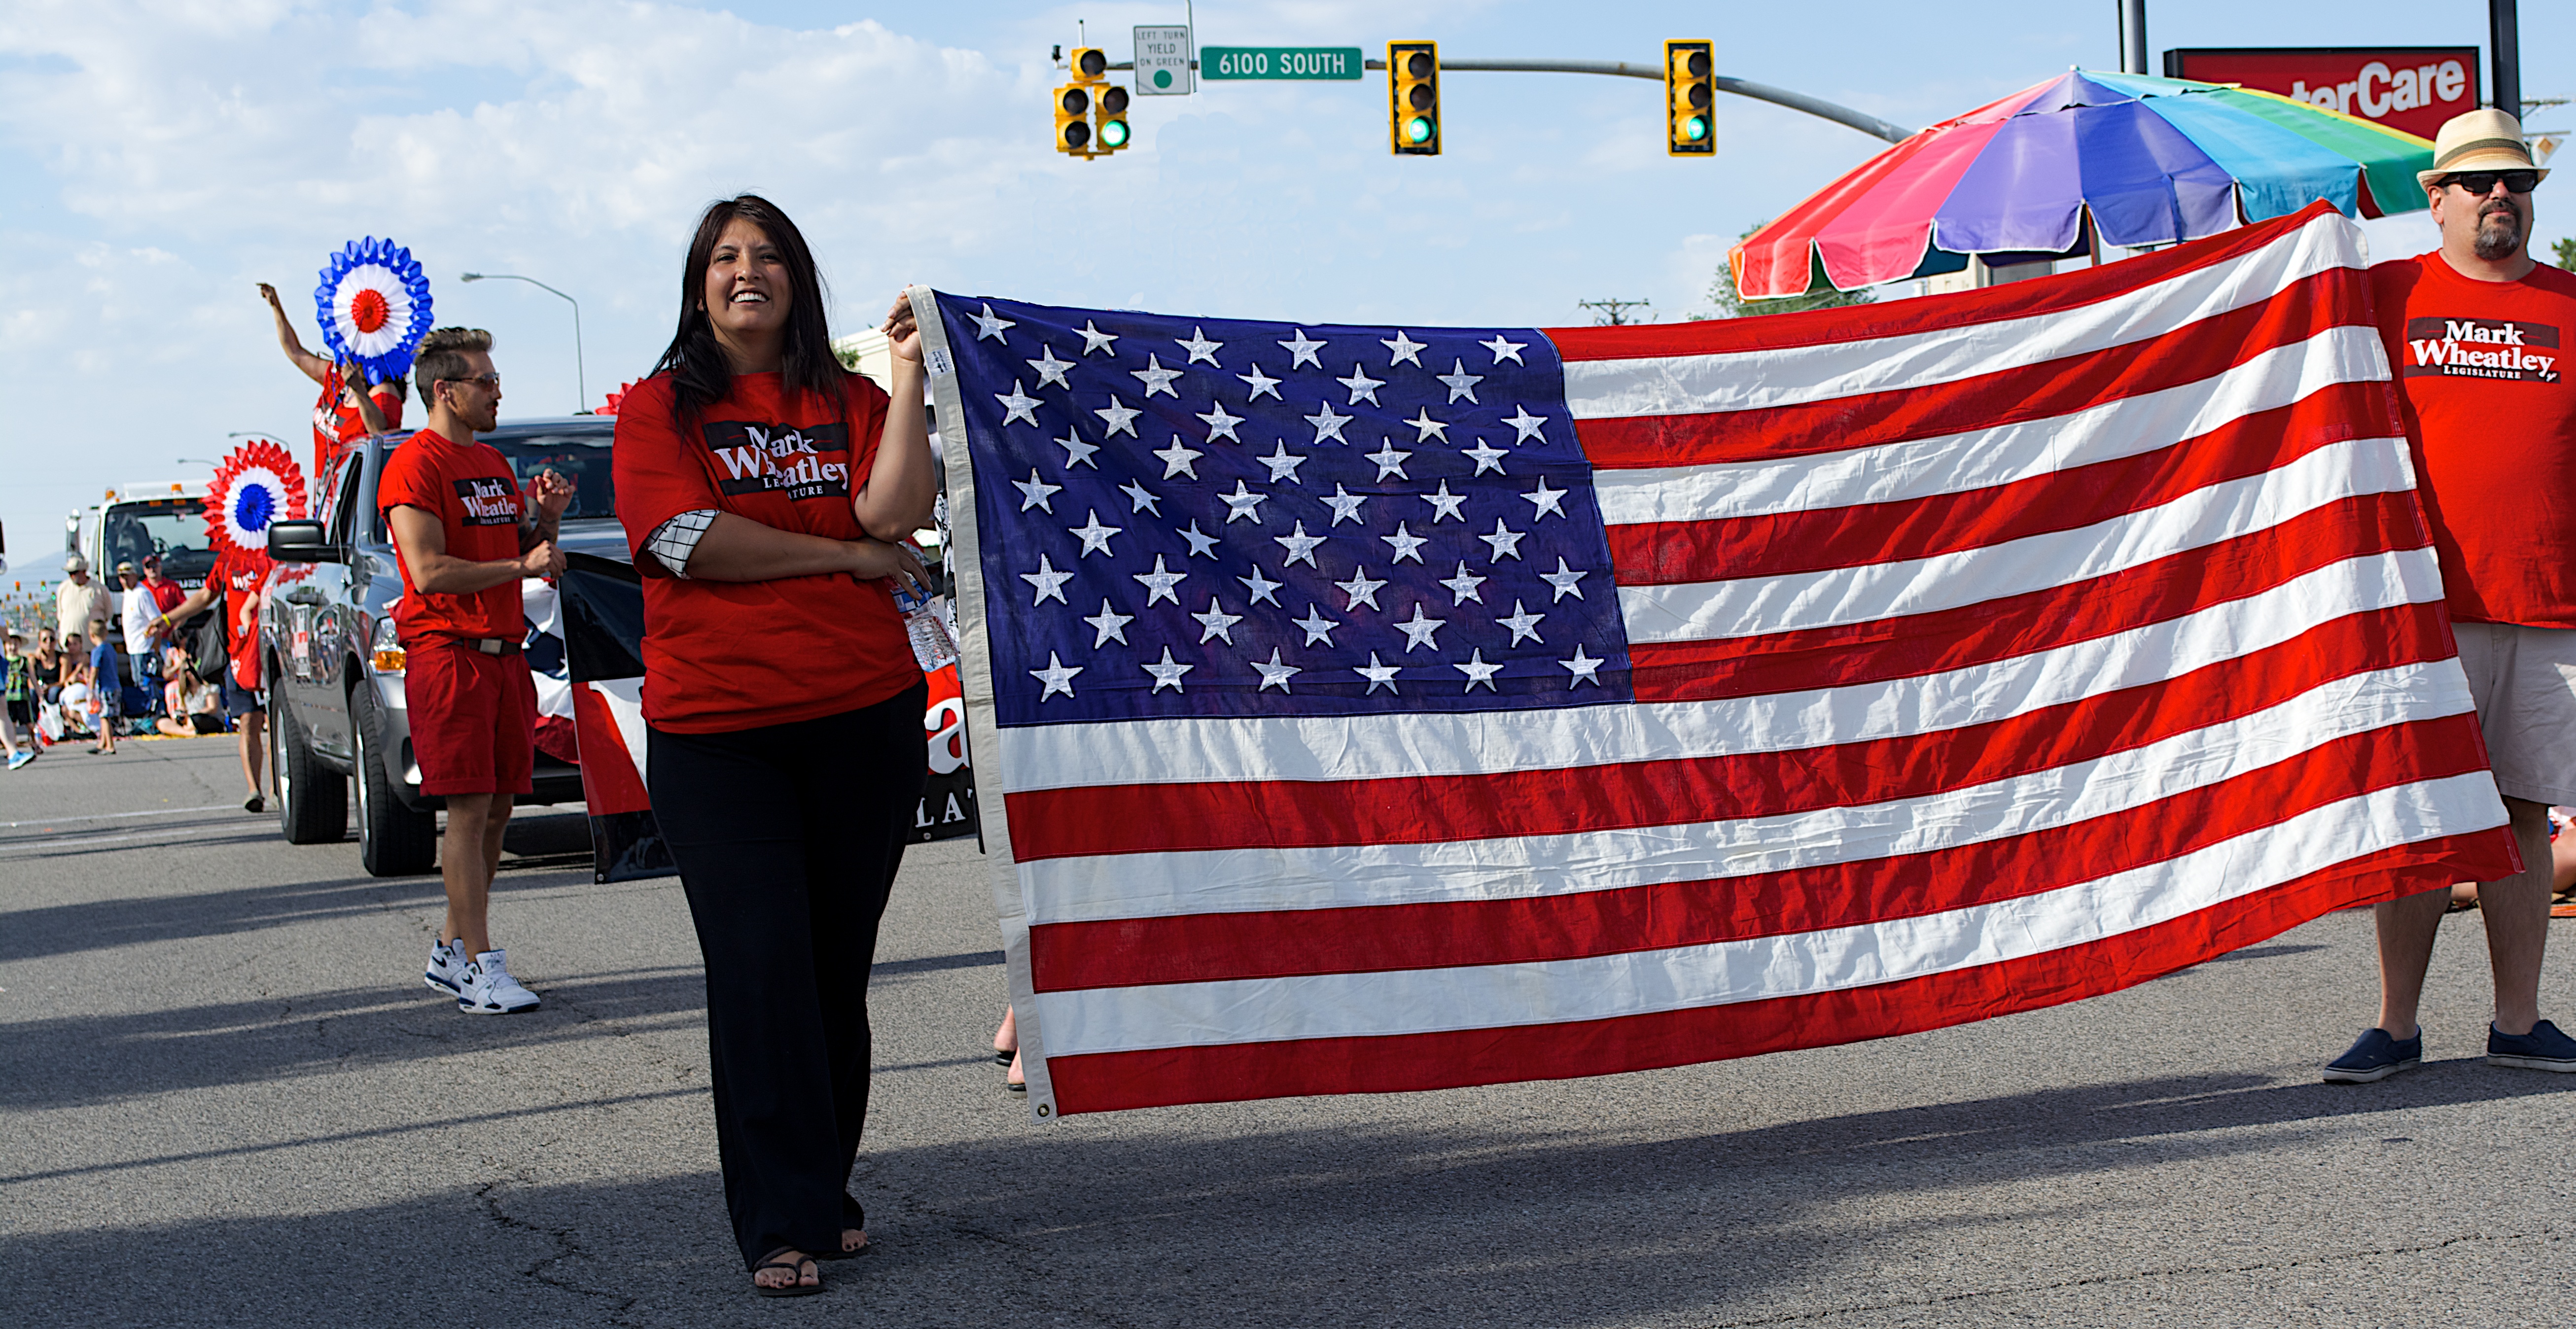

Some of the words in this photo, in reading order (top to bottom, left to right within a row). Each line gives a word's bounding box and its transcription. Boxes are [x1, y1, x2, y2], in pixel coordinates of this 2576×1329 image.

[1137, 32, 1156, 40] LEFT
[1164, 31, 1185, 39] TURN
[1147, 43, 1176, 54] YIELD
[1140, 58, 1151, 67] ON
[1157, 57, 1185, 66] GREEN
[1219, 53, 1268, 74] 6100
[1280, 53, 1345, 74] SOUTH
[2291, 59, 2466, 118] terCare
[2444, 320, 2525, 346] Mark
[2409, 339, 2555, 378] Wheatley
[2443, 365, 2521, 380] LEGISLATURE
[744, 426, 819, 458] Mark
